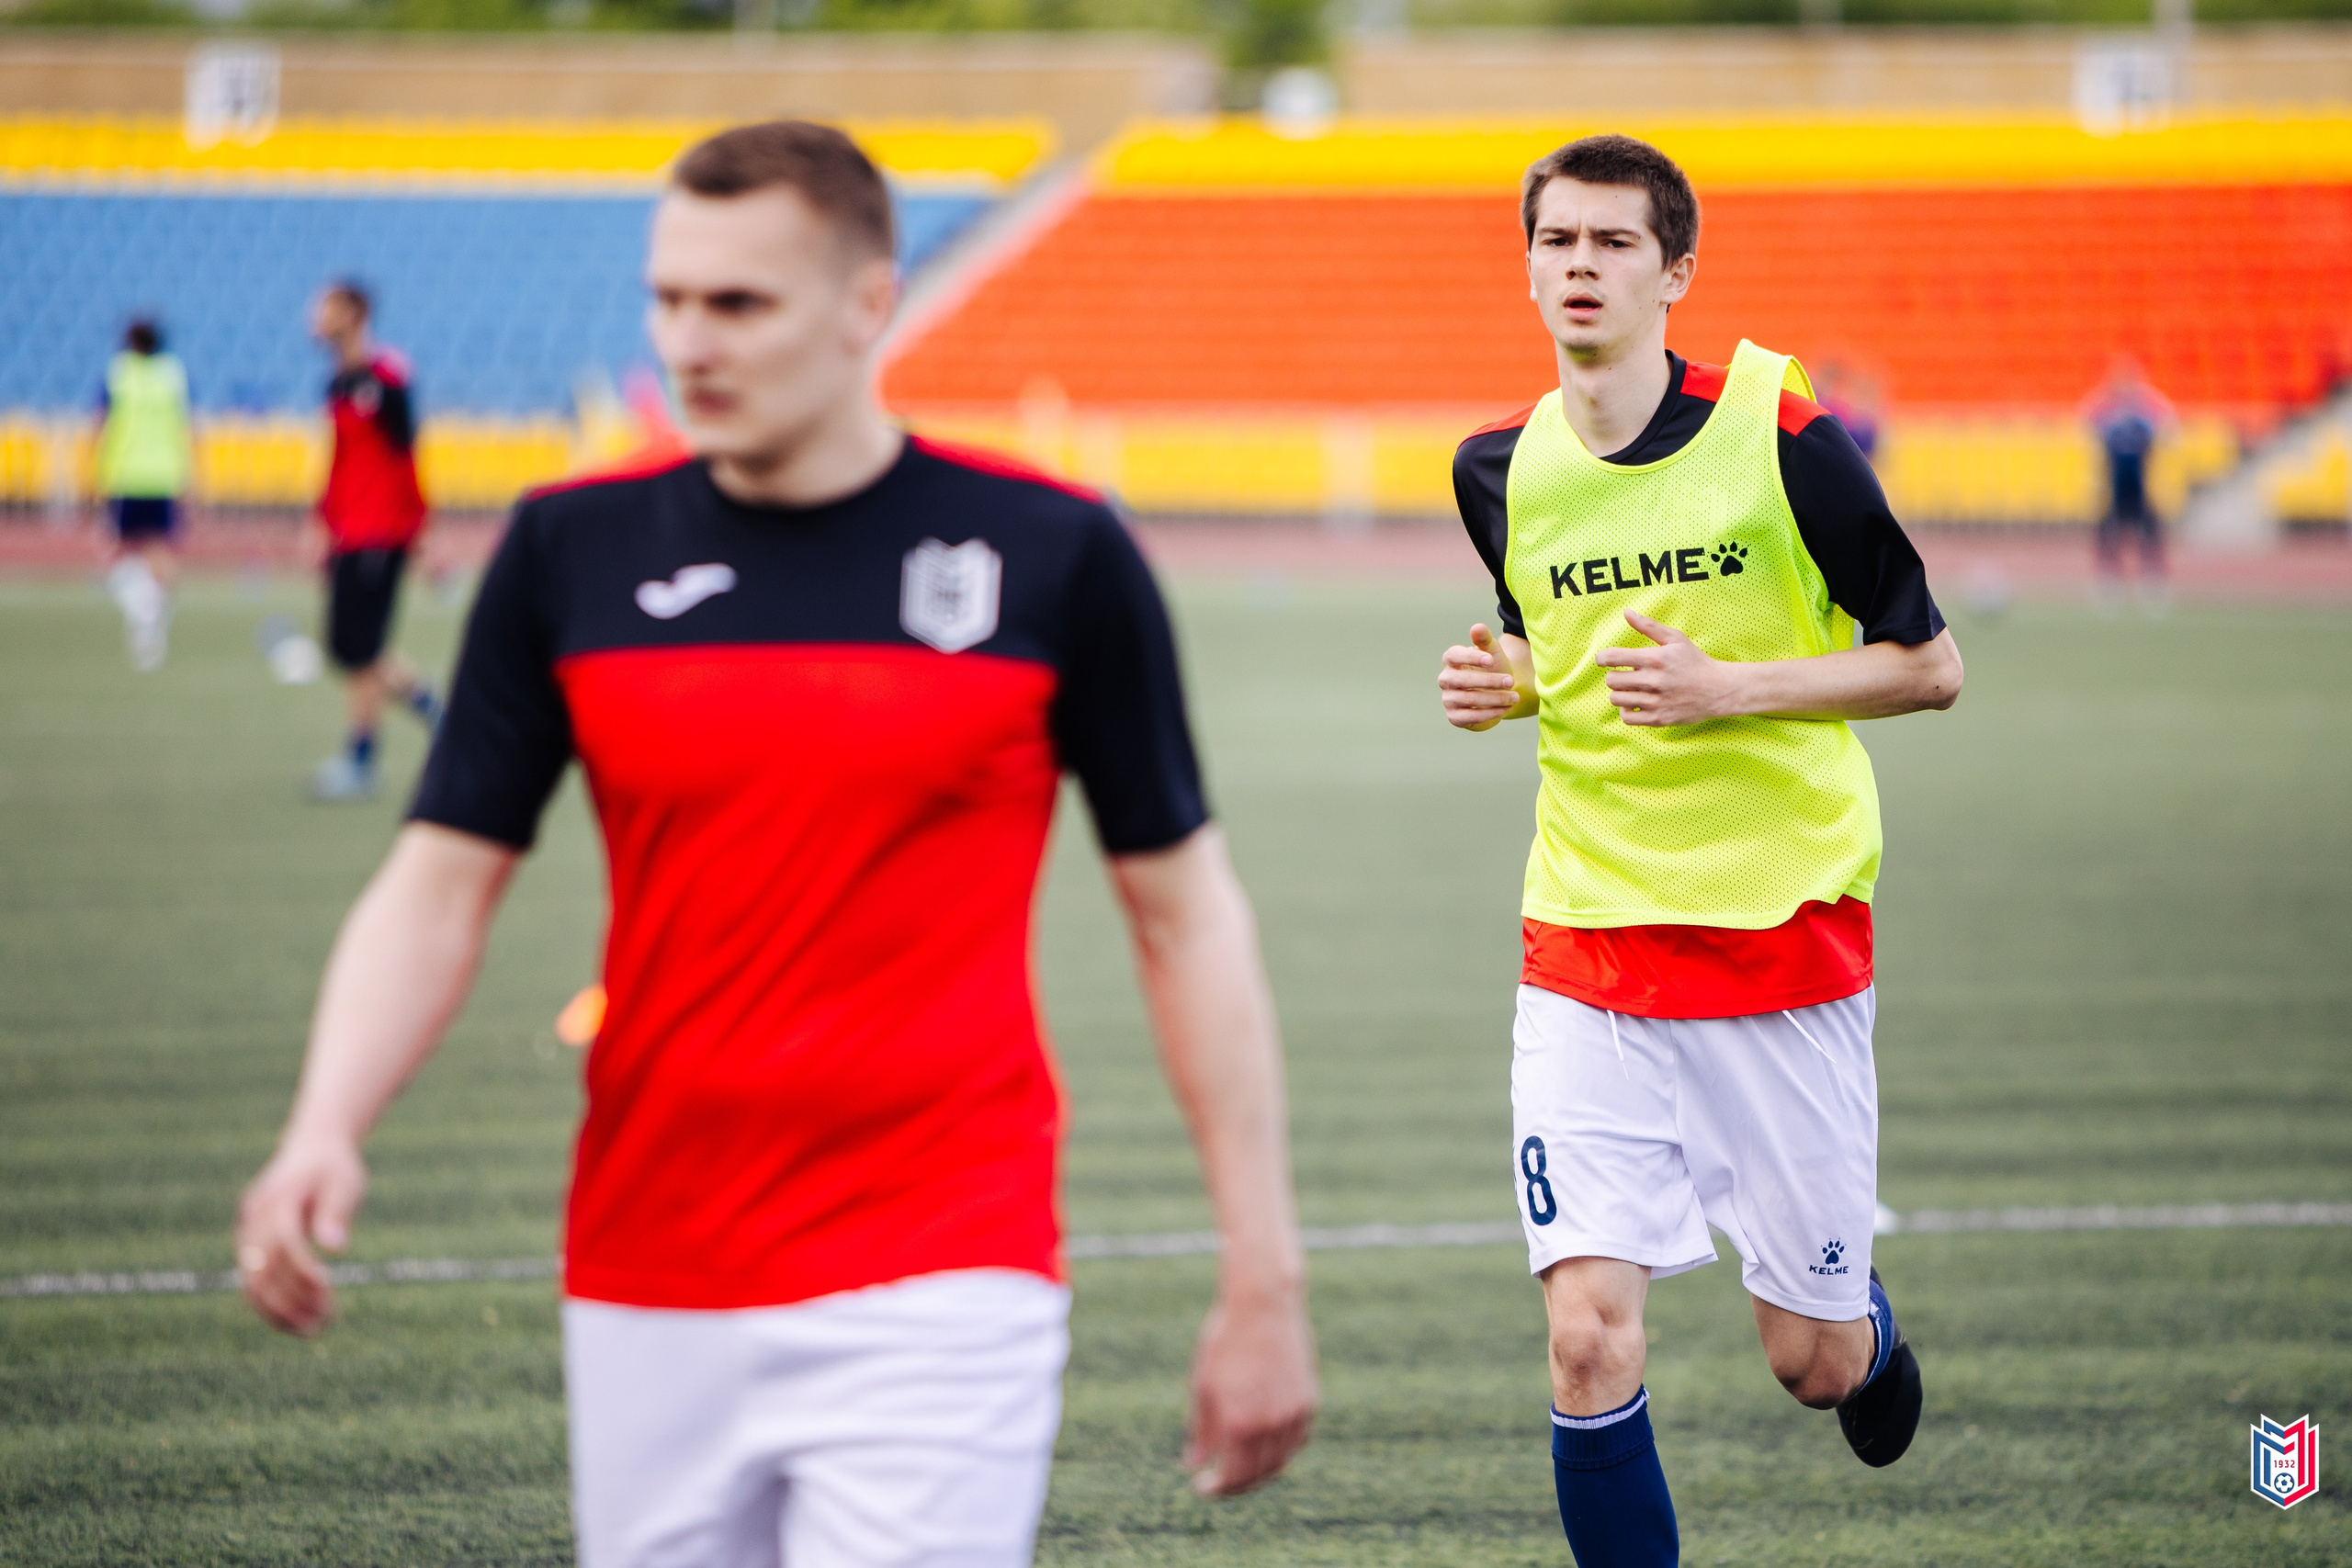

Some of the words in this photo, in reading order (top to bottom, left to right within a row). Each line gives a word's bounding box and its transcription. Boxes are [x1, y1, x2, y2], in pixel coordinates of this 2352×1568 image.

[1549, 547, 1710, 599] KELME
[1521, 1135, 1557, 1226] 8
[1809, 1265, 1849, 1275] KELME
